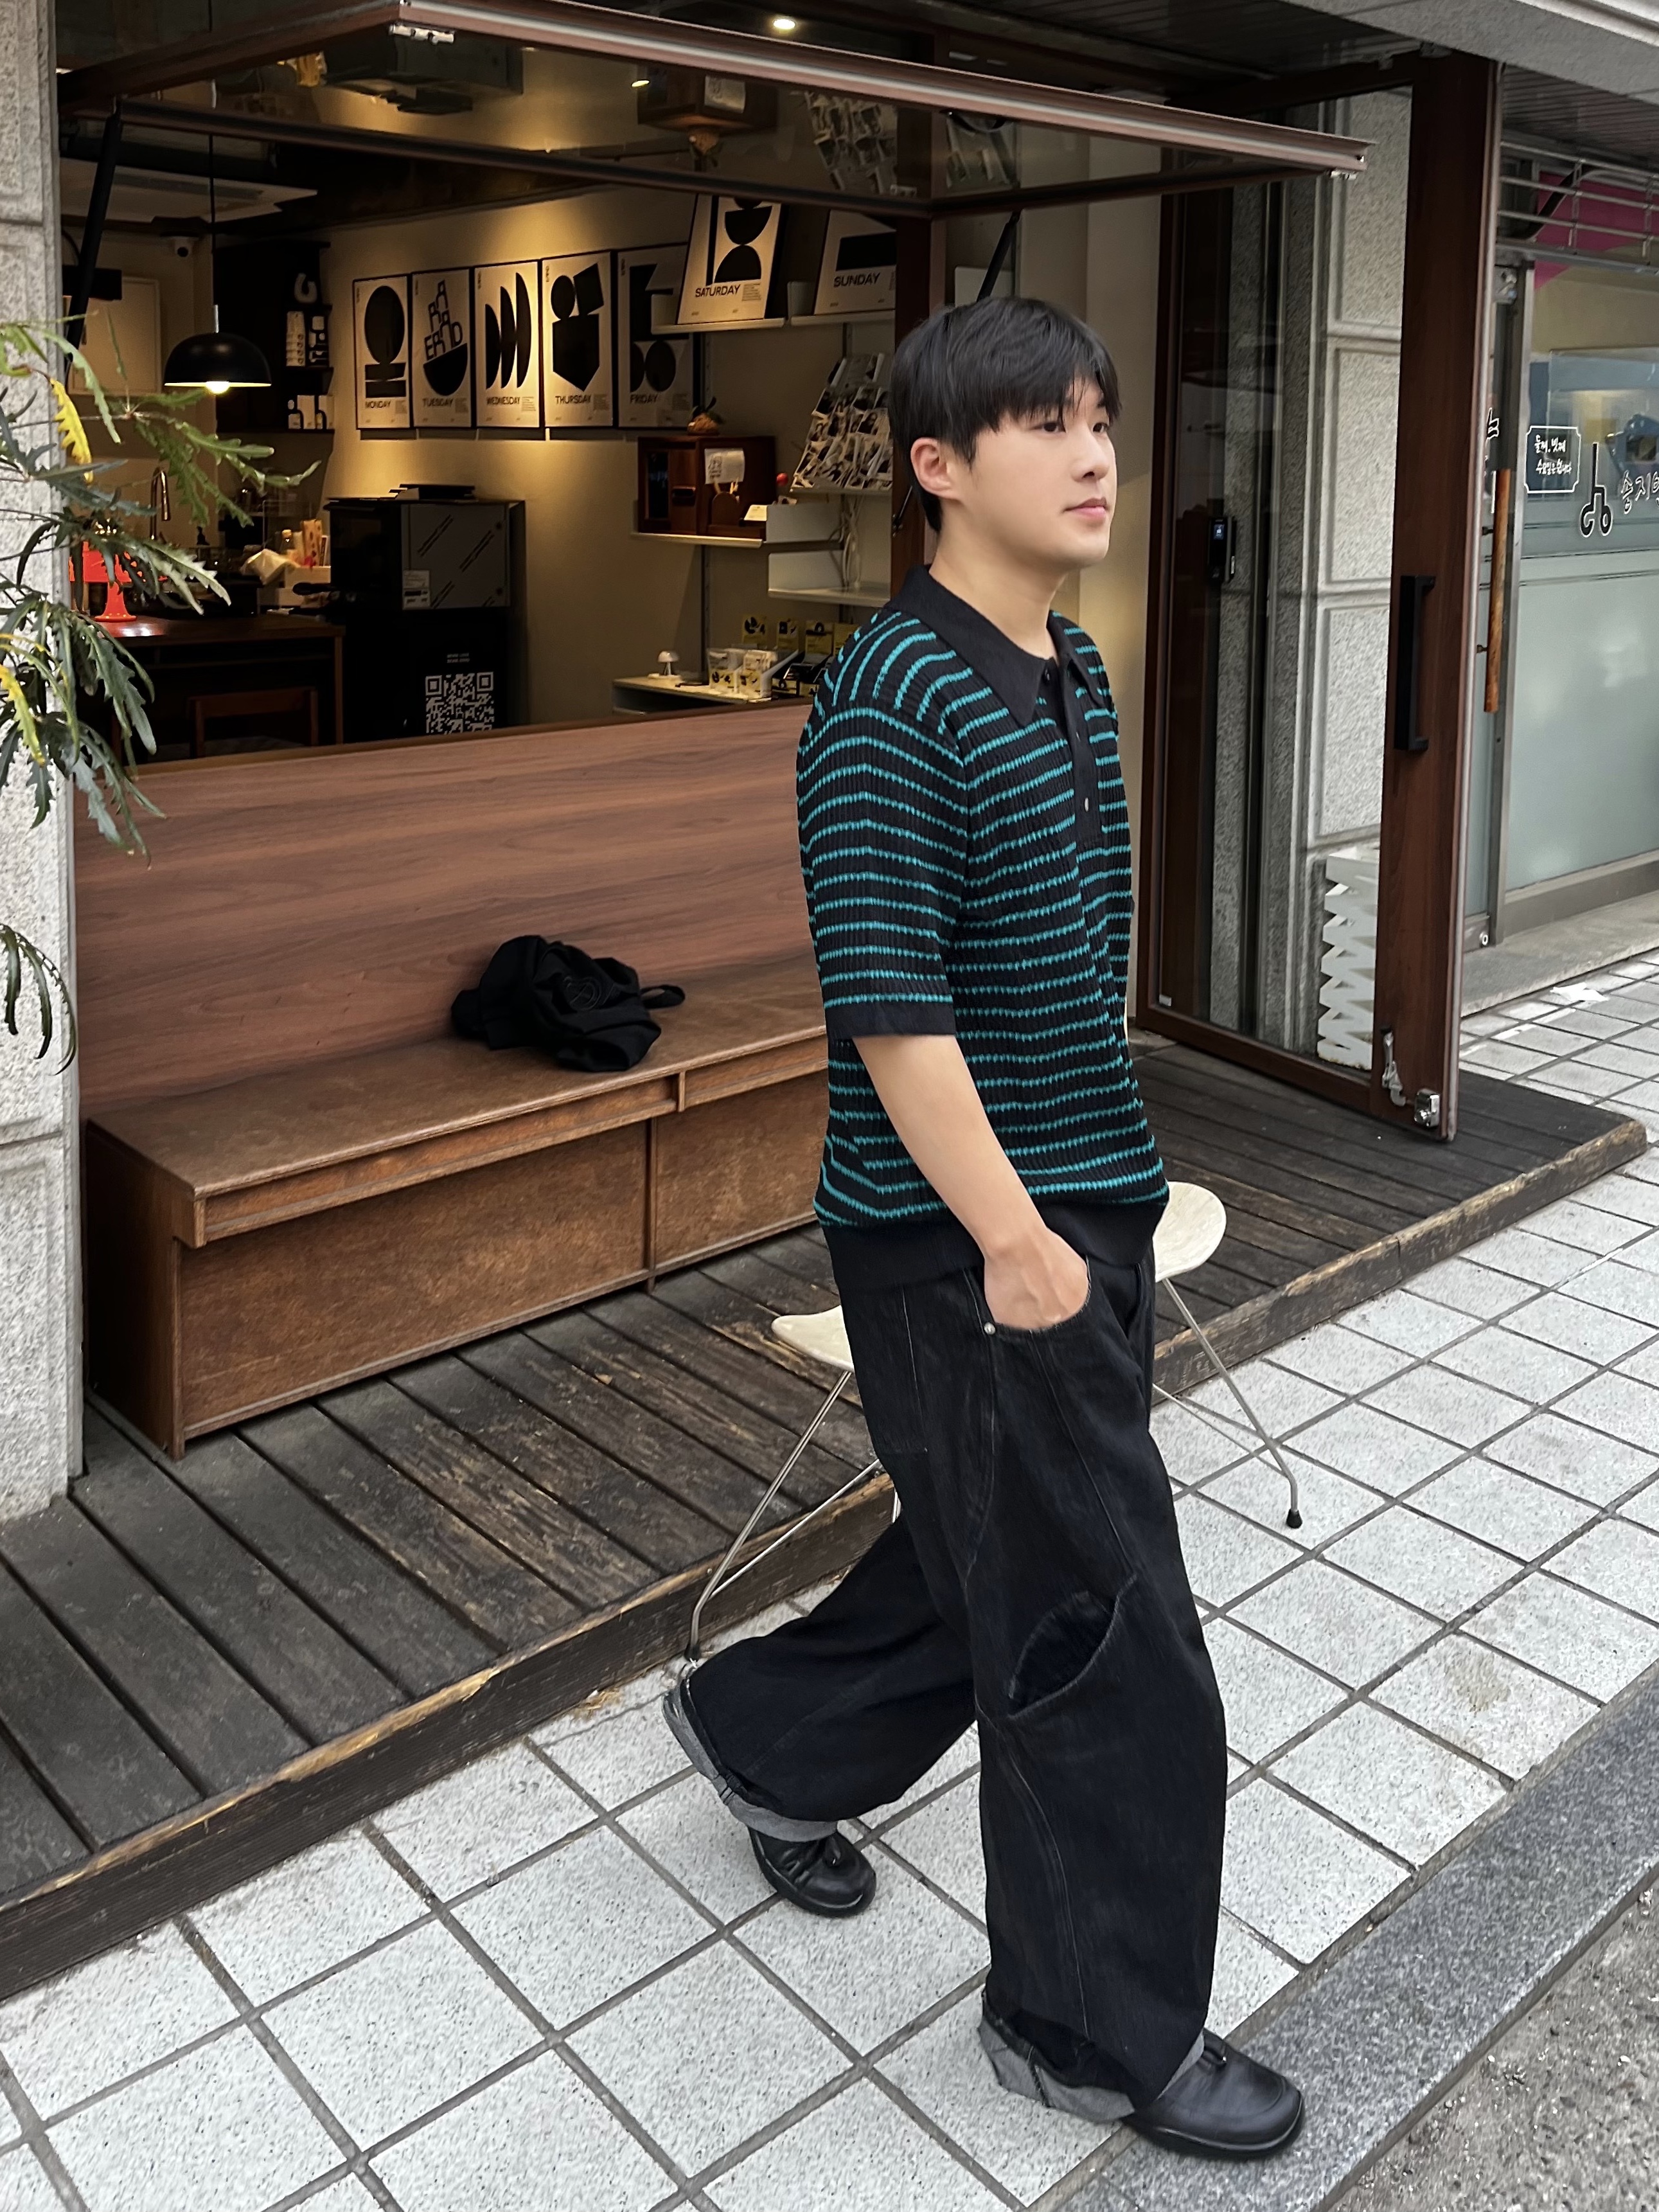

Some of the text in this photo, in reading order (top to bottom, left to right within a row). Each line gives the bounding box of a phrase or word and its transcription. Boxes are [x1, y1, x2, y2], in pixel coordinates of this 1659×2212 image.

[833, 272, 881, 288] SUNDAY
[695, 284, 741, 298] SATURDAY
[421, 397, 454, 407] TUESDAY
[486, 396, 520, 406] WEDNESDAY
[554, 394, 592, 405] THURSDAY
[630, 393, 658, 404] FRIDAY
